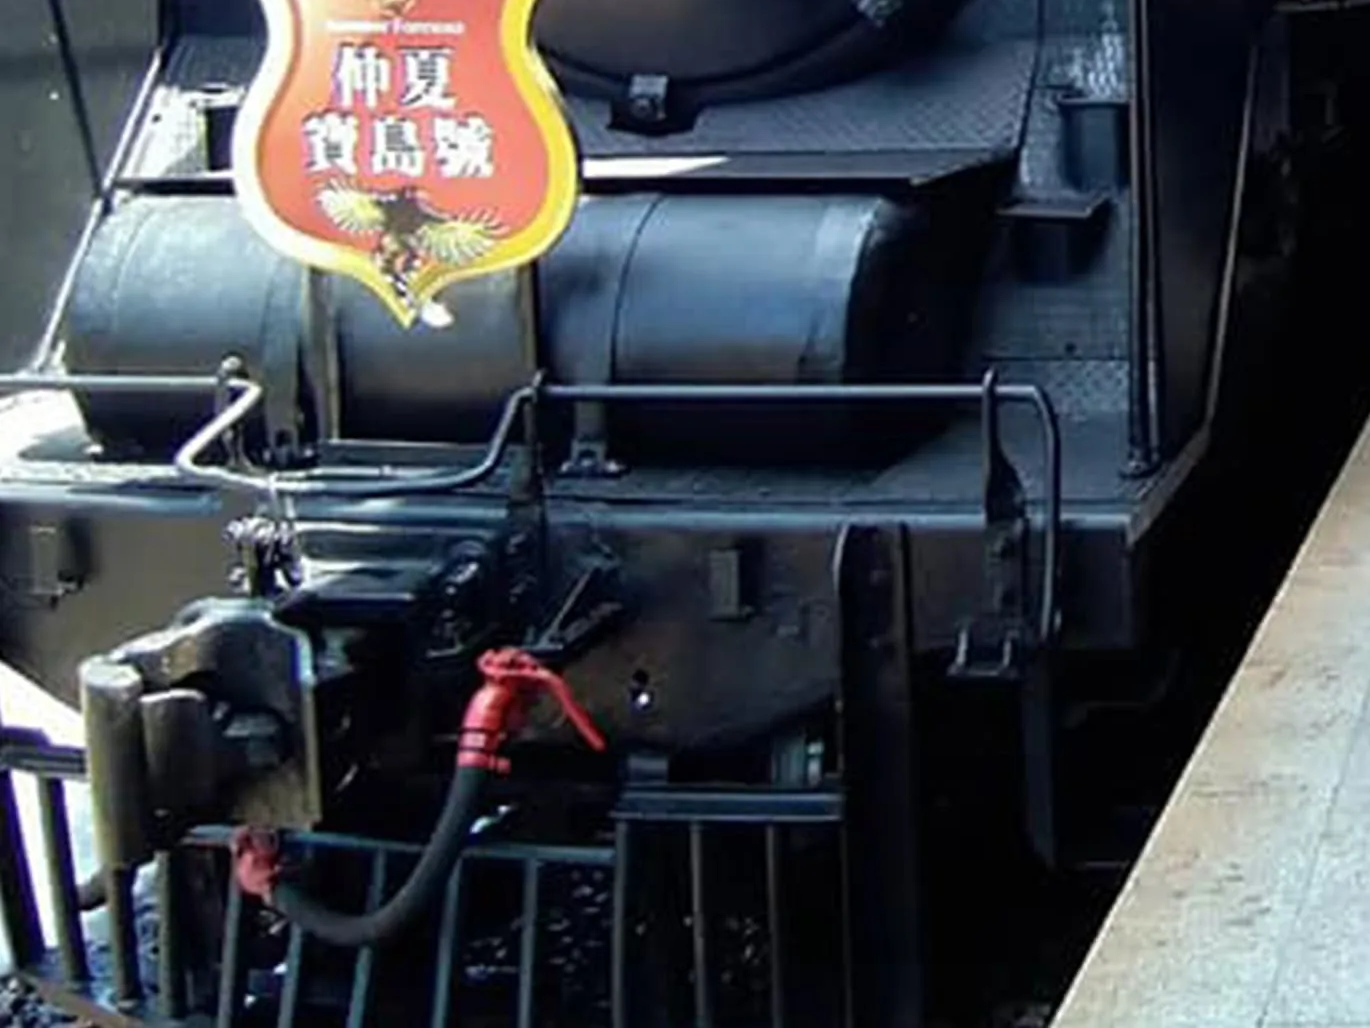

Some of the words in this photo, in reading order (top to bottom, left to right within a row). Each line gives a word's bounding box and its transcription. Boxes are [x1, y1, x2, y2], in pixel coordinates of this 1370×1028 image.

[332, 43, 457, 111] 仲夏
[302, 110, 496, 178] 寶島號
